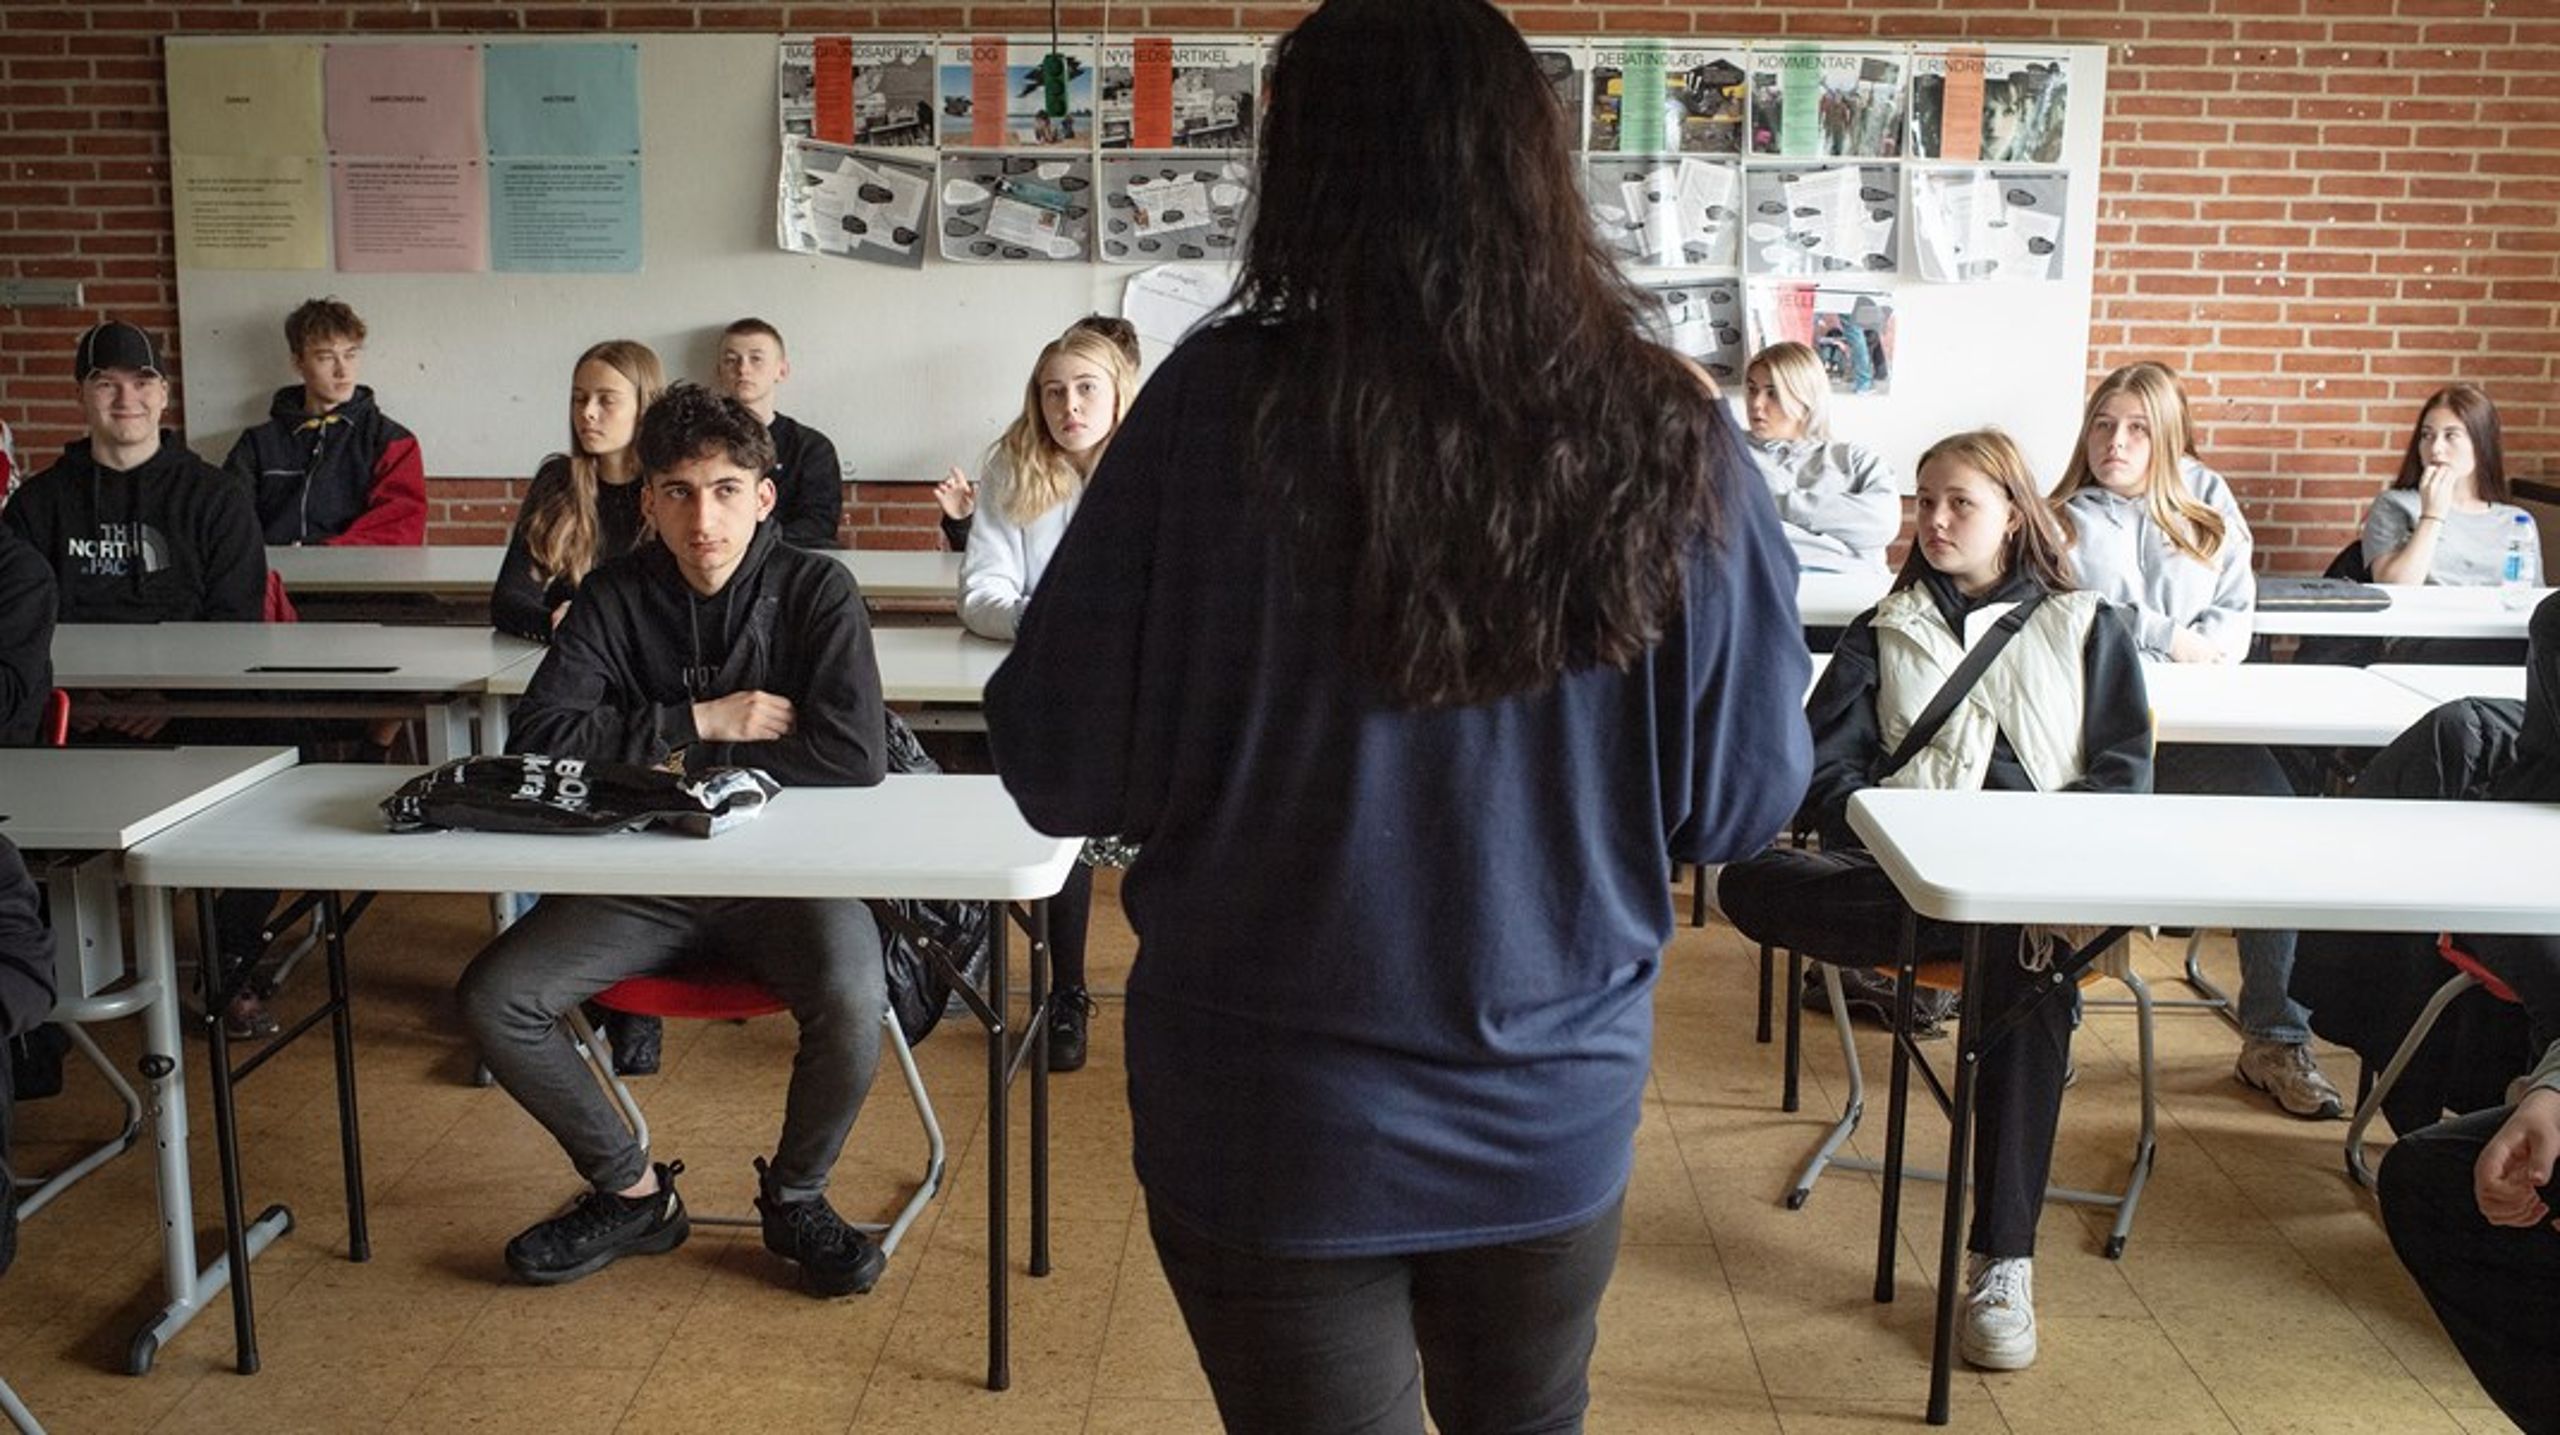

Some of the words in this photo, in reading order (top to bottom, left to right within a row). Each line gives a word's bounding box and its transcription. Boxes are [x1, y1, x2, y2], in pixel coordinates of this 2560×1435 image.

[956, 48, 998, 62] BLOG
[1105, 49, 1230, 63] NYHEDSARTIKEL
[1595, 51, 1705, 67] DEBATINDLÆG
[1758, 55, 1857, 70] KOMMENTAR
[1918, 58, 2004, 74] ERINDRING
[68, 537, 139, 559] NORTH
